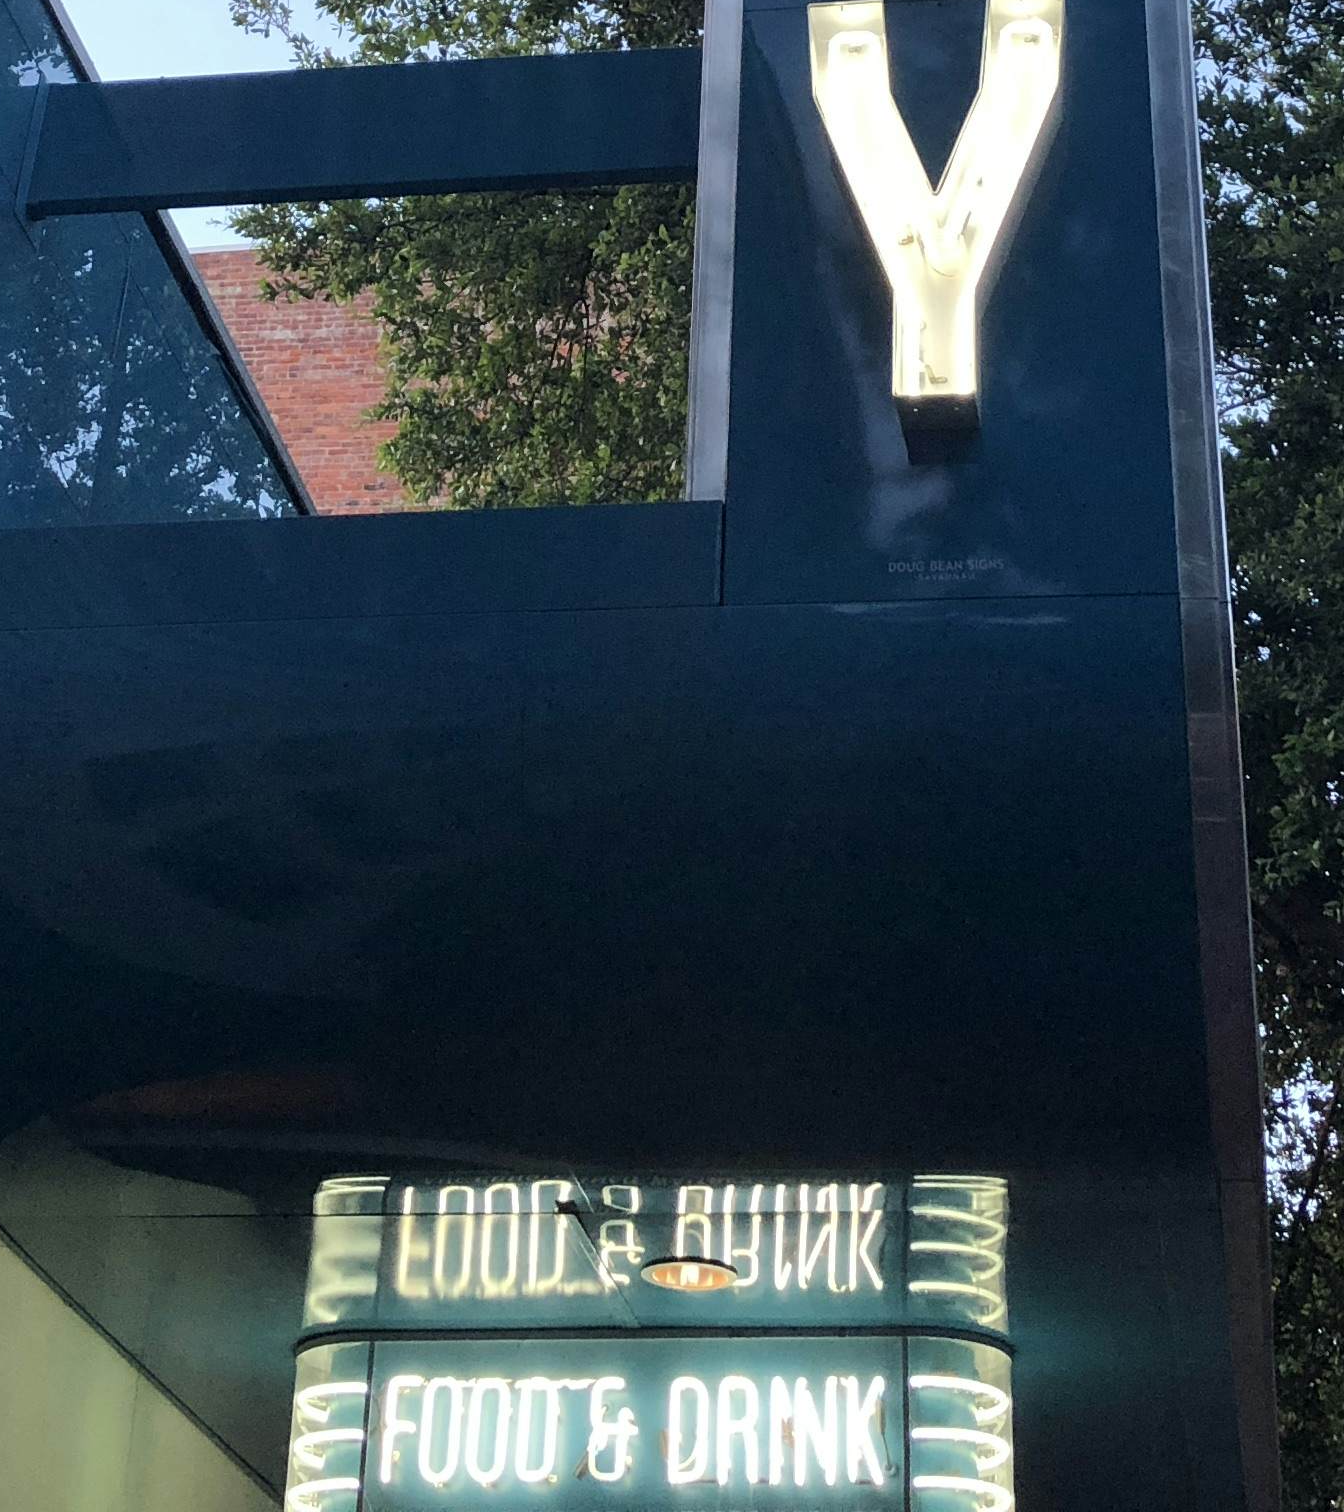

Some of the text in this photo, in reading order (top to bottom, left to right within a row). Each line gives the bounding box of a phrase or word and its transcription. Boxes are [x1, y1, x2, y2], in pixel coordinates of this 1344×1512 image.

[887, 558, 1005, 573] DOUG BEAN SIGNS
[377, 1373, 887, 1487] FOOD & DRINK
